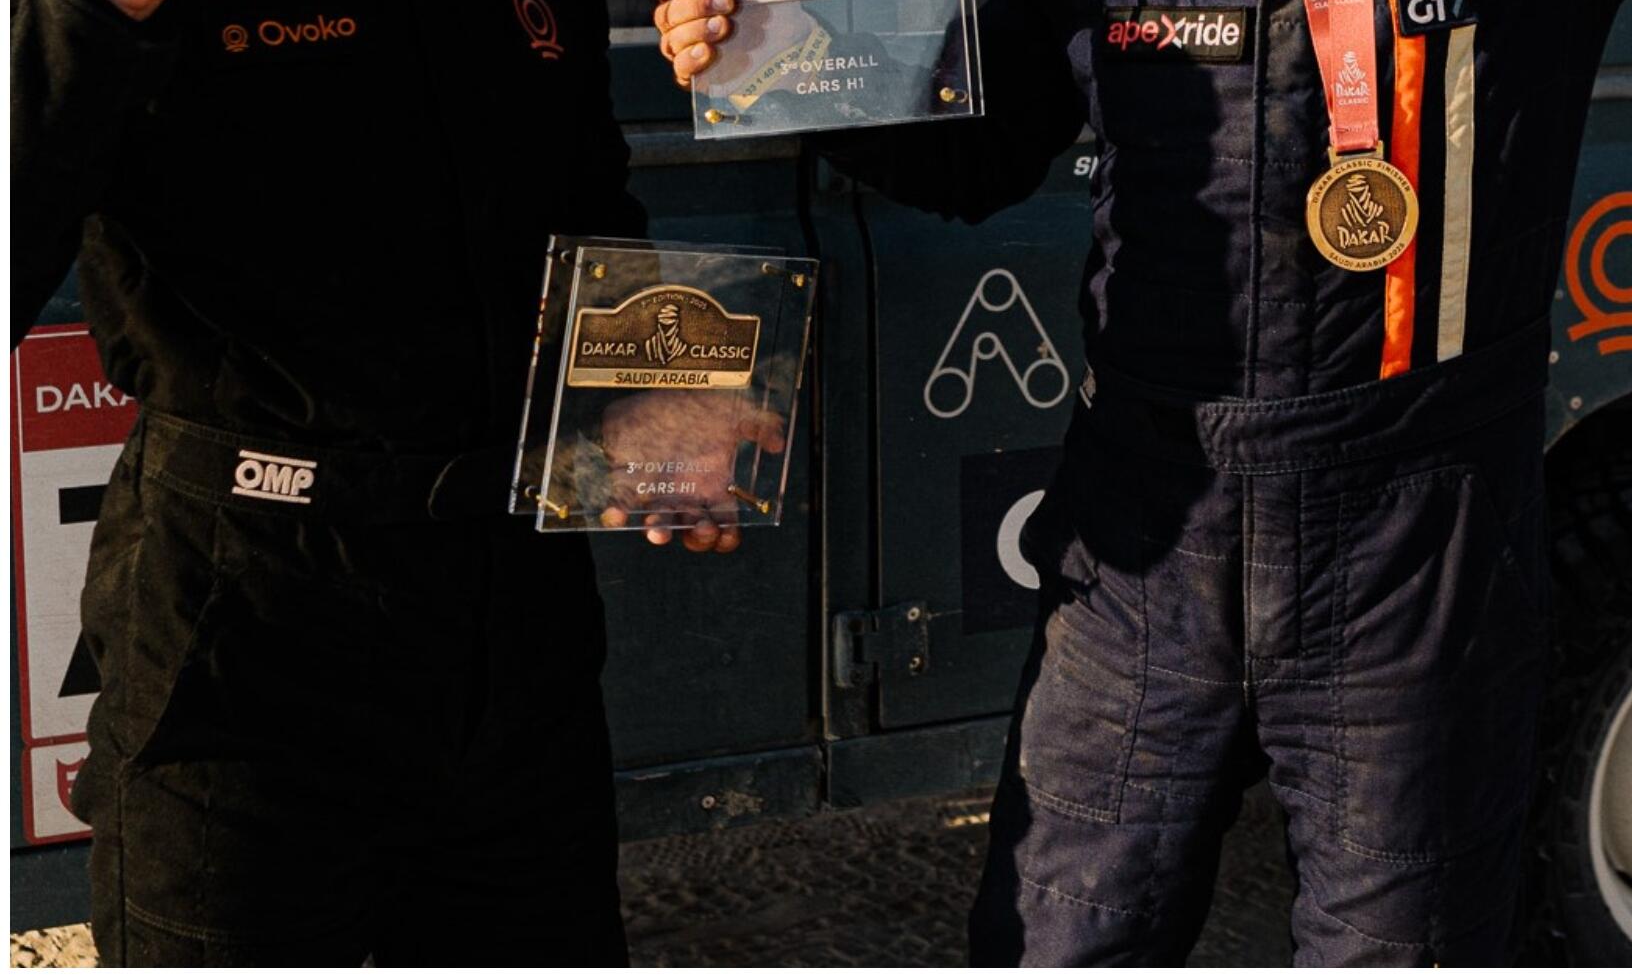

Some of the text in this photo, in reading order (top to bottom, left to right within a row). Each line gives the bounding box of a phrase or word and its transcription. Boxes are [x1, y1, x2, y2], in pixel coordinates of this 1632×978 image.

[258, 15, 356, 46] Ovoko
[800, 55, 879, 73] OVERALL
[796, 77, 864, 95] CARS H1
[1337, 221, 1394, 249] DAKAR
[581, 341, 750, 359] DAKAR CLASSIC
[614, 372, 709, 386] SAUDI ARABIA
[645, 462, 711, 474] OVERALL
[235, 459, 315, 496] OMP
[636, 482, 676, 495] CARS
